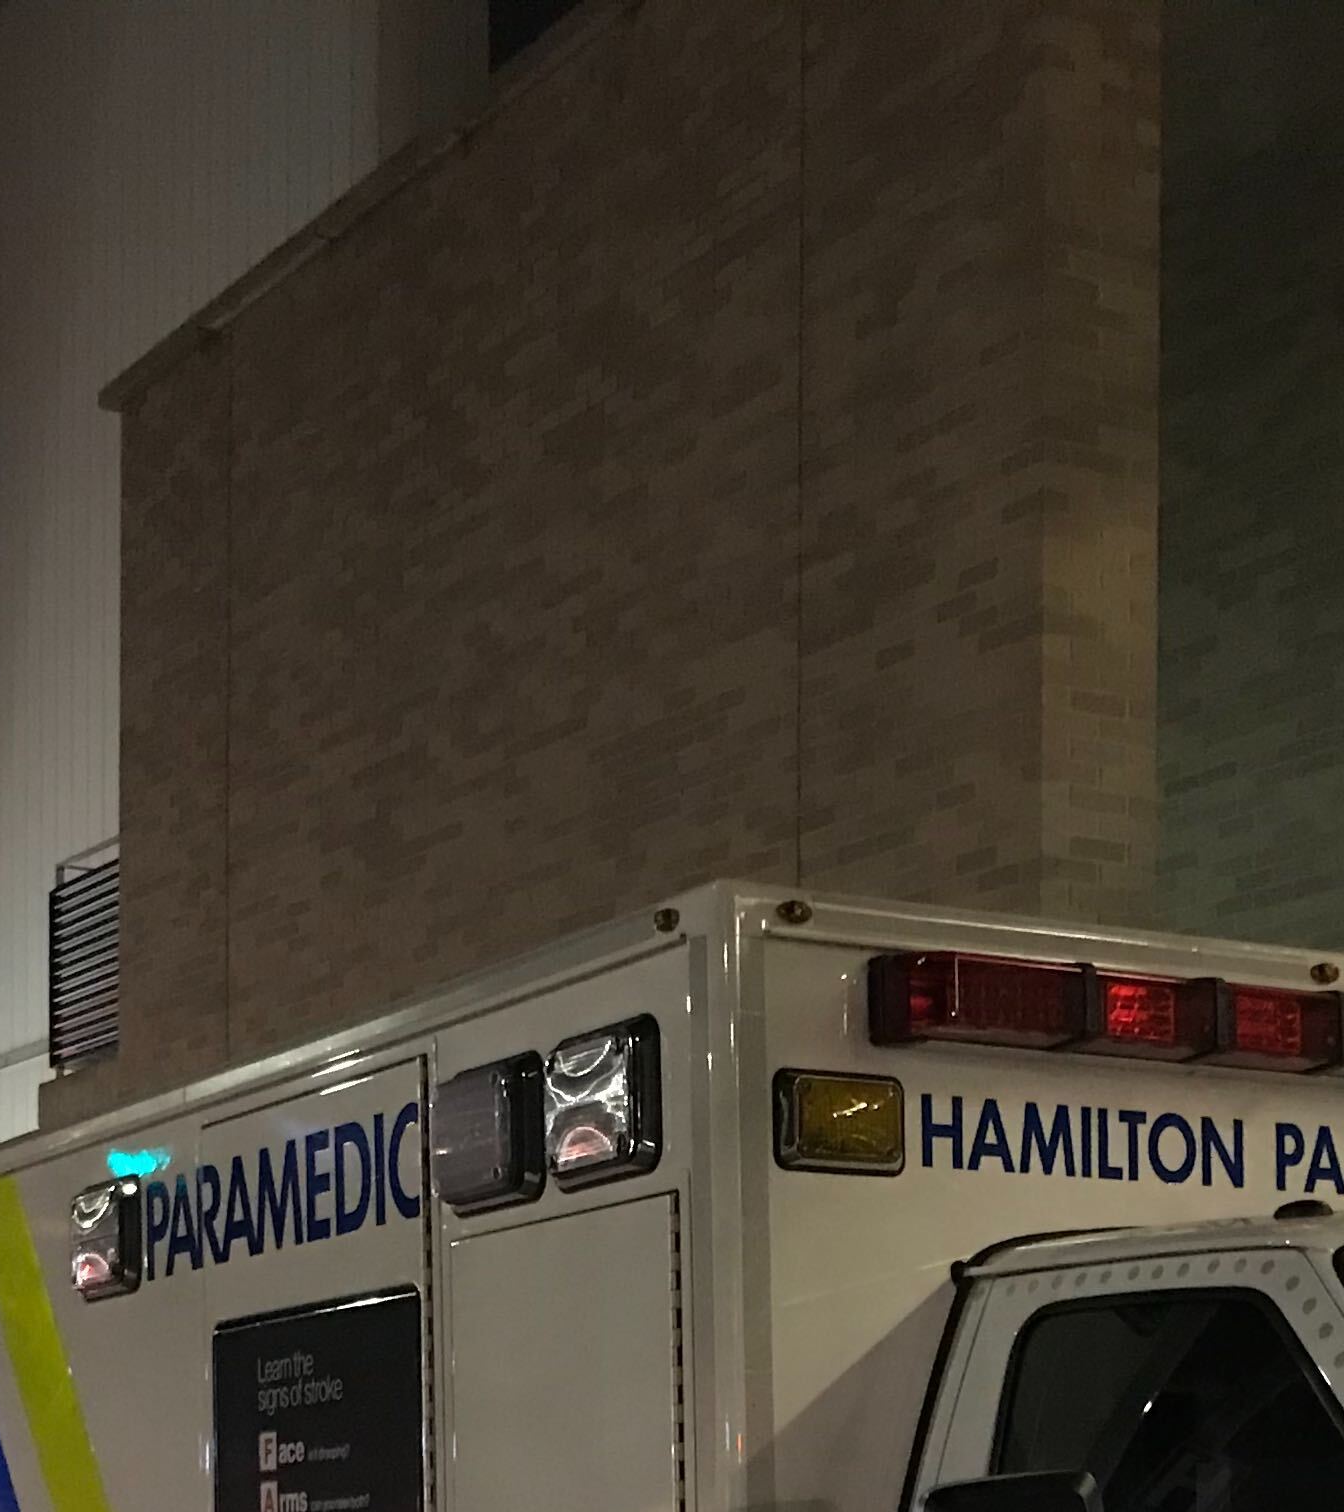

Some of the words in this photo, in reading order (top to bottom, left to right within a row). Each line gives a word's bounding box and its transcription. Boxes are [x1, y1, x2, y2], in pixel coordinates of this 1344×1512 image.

[920, 1093, 1244, 1188] HAMILTON
[146, 1102, 421, 1281] PARAMEDIC
[257, 1356, 292, 1383] Learn
[293, 1350, 314, 1377] the
[257, 1384, 289, 1416] signs
[290, 1377, 303, 1406] of
[304, 1374, 344, 1405] stroke
[261, 1435, 306, 1467] Face
